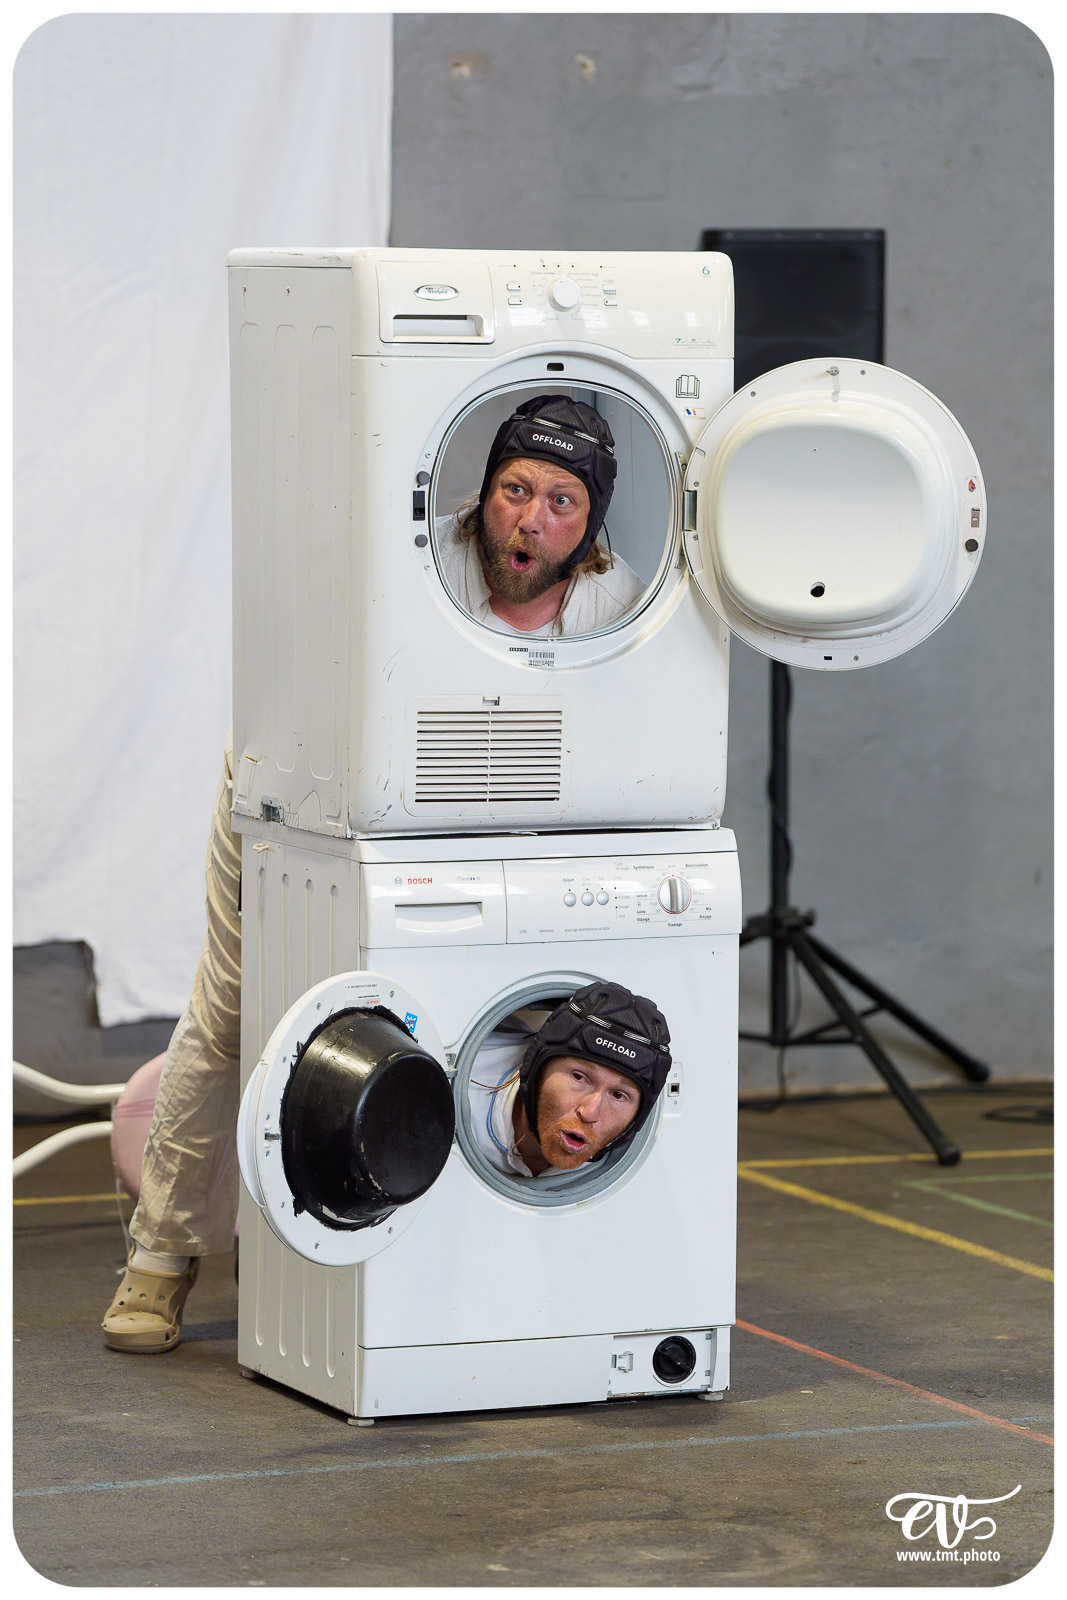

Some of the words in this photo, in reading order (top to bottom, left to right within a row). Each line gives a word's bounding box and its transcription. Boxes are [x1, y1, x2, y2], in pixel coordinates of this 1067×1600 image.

[532, 433, 574, 451] OFFLOAD
[407, 877, 433, 885] BOSCH
[595, 1037, 637, 1059] OFFLOAD
